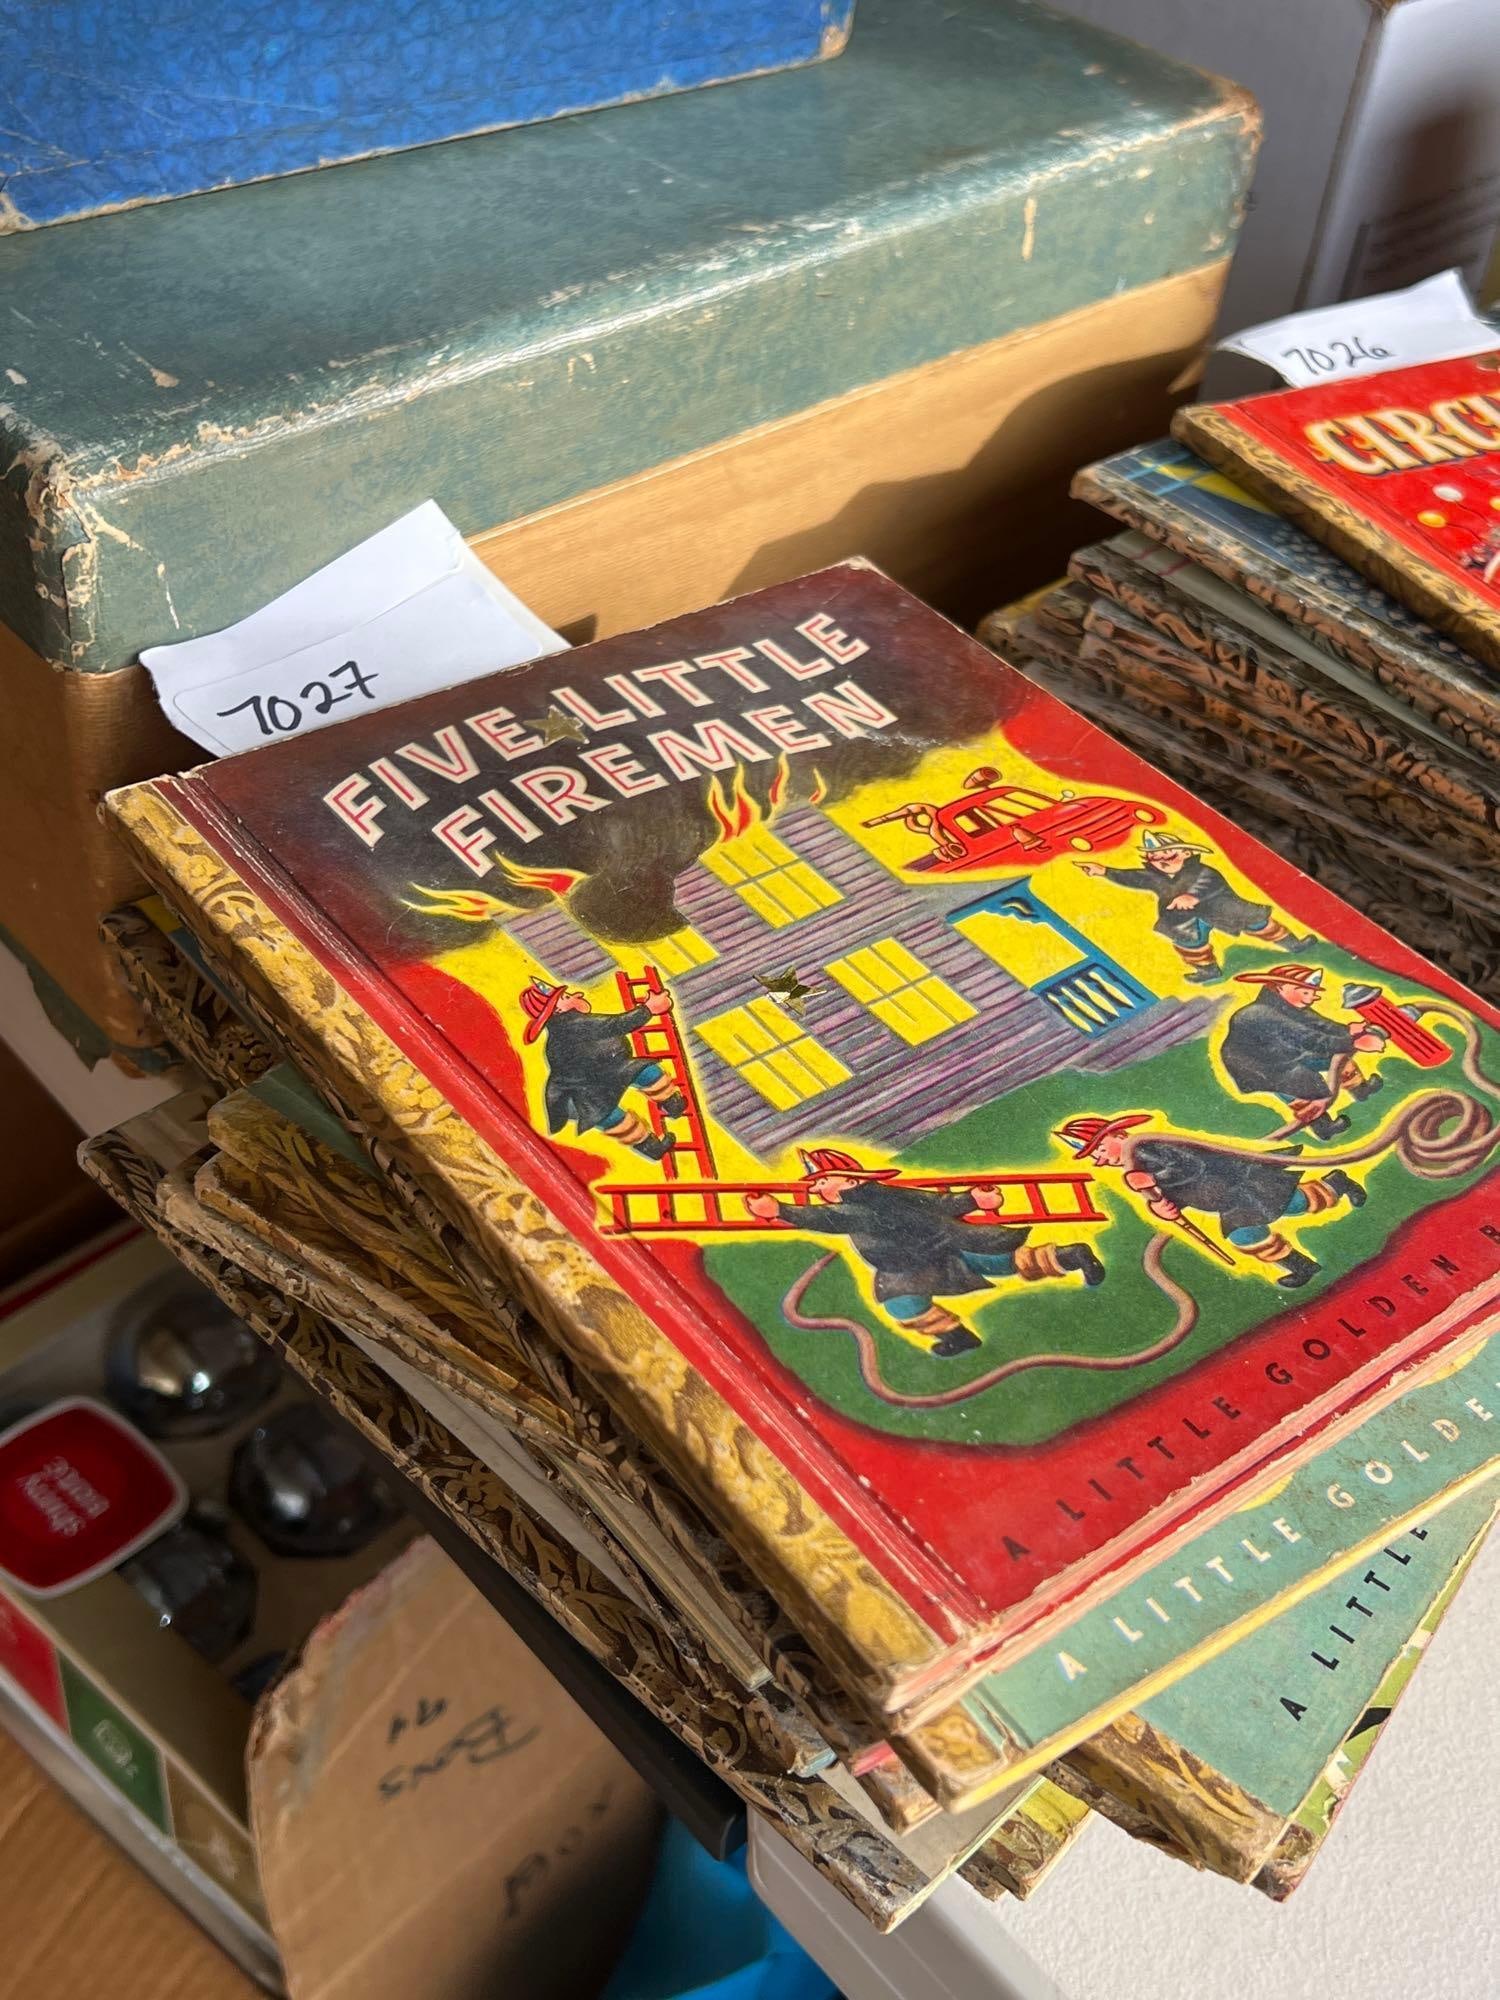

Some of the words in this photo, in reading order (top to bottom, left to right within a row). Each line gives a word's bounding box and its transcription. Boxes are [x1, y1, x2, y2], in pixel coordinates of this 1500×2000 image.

[217, 660, 379, 735] 7027
[323, 706, 548, 849] FIVE
[551, 612, 870, 732] LITTLE
[432, 681, 898, 878] FIREMEN
[1002, 1536, 1031, 1562] A
[1055, 1397, 1241, 1521] LITTLE
[1265, 1254, 1460, 1384] GOLDEN
[1058, 1651, 1088, 1680] A
[1112, 1517, 1302, 1643] LITTLE
[1326, 1381, 1500, 1509] GOLDE
[1279, 1697, 1308, 1722] A
